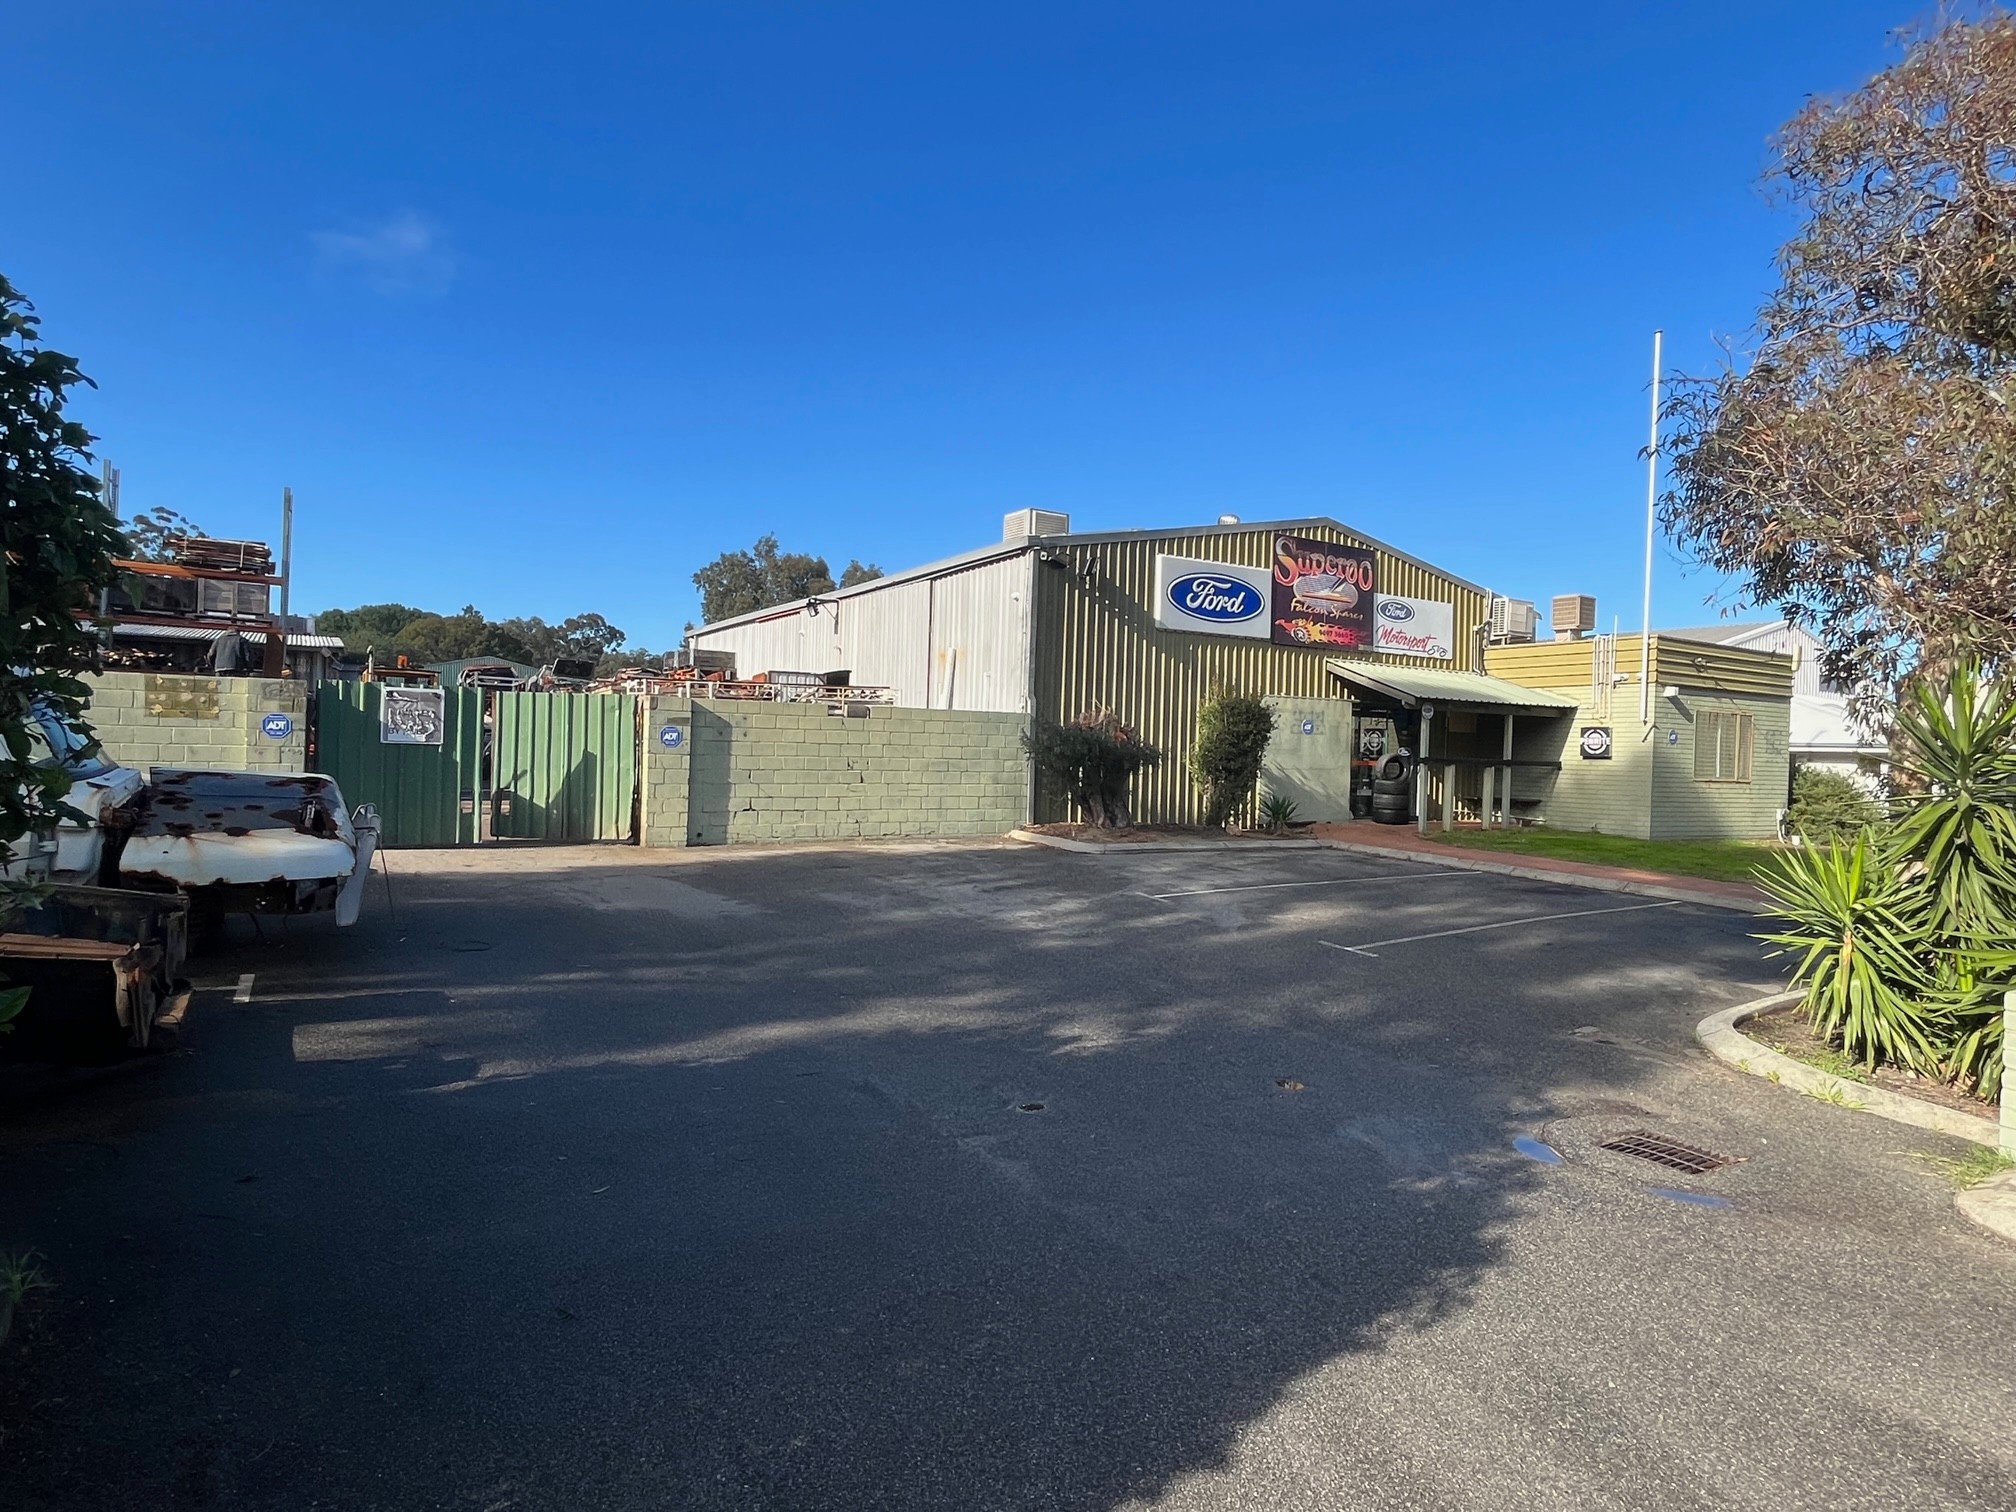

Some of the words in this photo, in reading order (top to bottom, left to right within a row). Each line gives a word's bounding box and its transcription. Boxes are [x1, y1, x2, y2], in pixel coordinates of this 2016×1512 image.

[1186, 578, 1246, 614] Ford
[1290, 598, 1328, 615] Falcon
[1330, 604, 1364, 621] Spares
[1385, 603, 1407, 618] Ford
[1376, 624, 1437, 652] Motorsport
[266, 720, 287, 730] ADT
[663, 732, 678, 741] ADT
